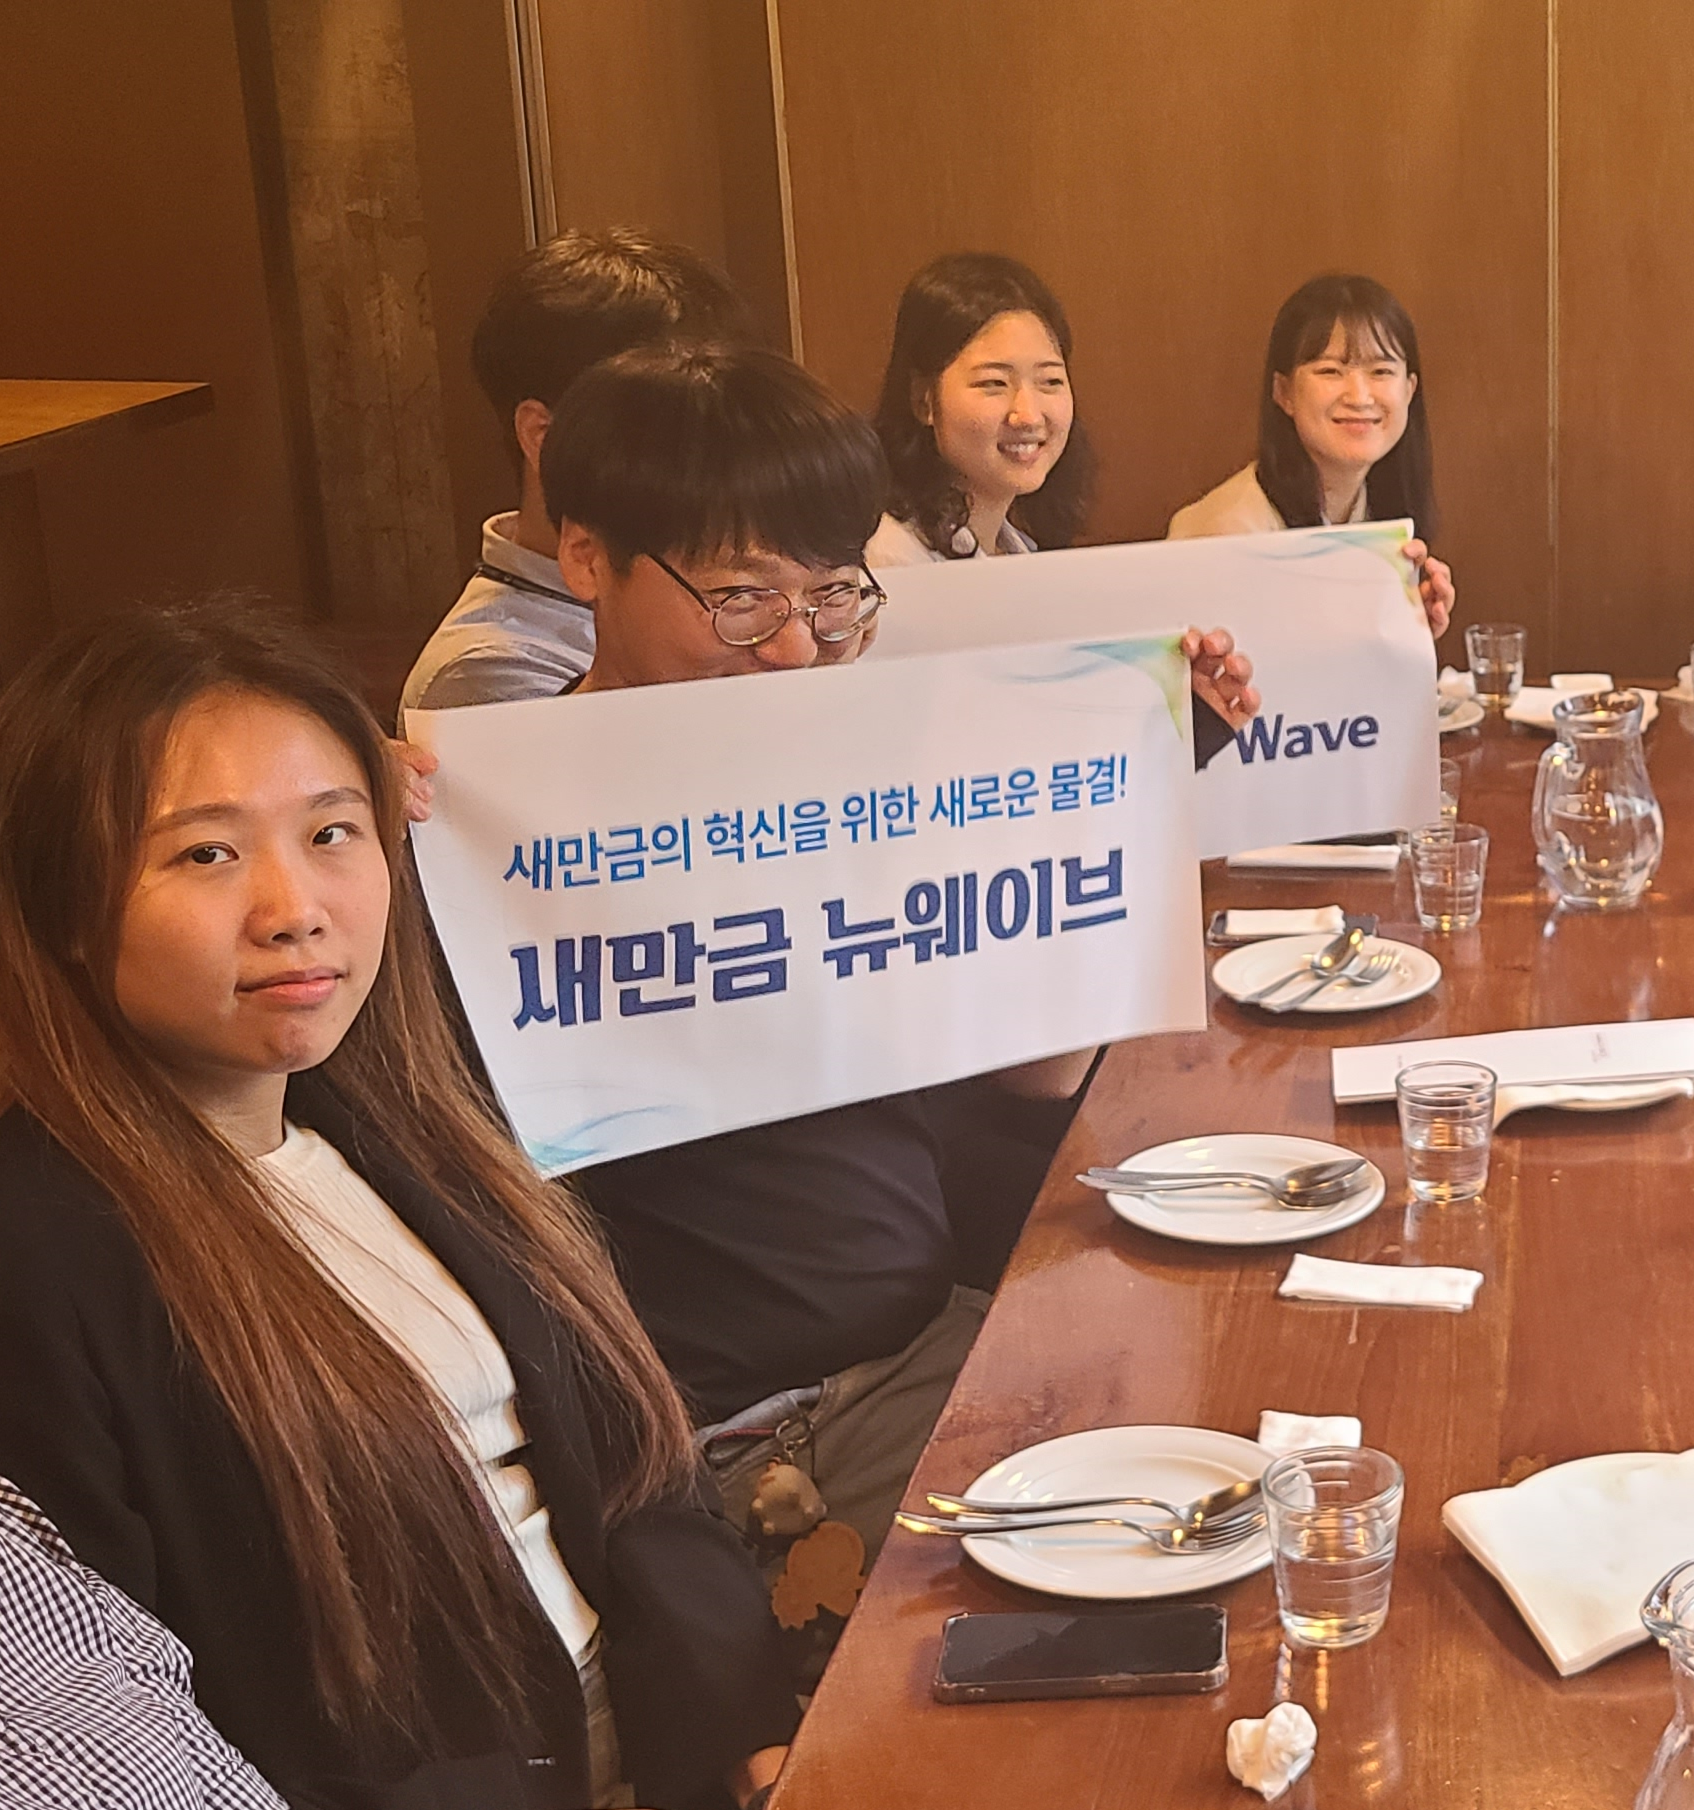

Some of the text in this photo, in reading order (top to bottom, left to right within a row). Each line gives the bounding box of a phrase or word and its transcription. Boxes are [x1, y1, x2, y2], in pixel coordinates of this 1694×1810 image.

[1236, 714, 1379, 765] Wave
[504, 754, 1128, 891] 새만금의 혁신을 위한 새로운 물결!
[510, 847, 1128, 1032] 새만금 뉴웨이브
